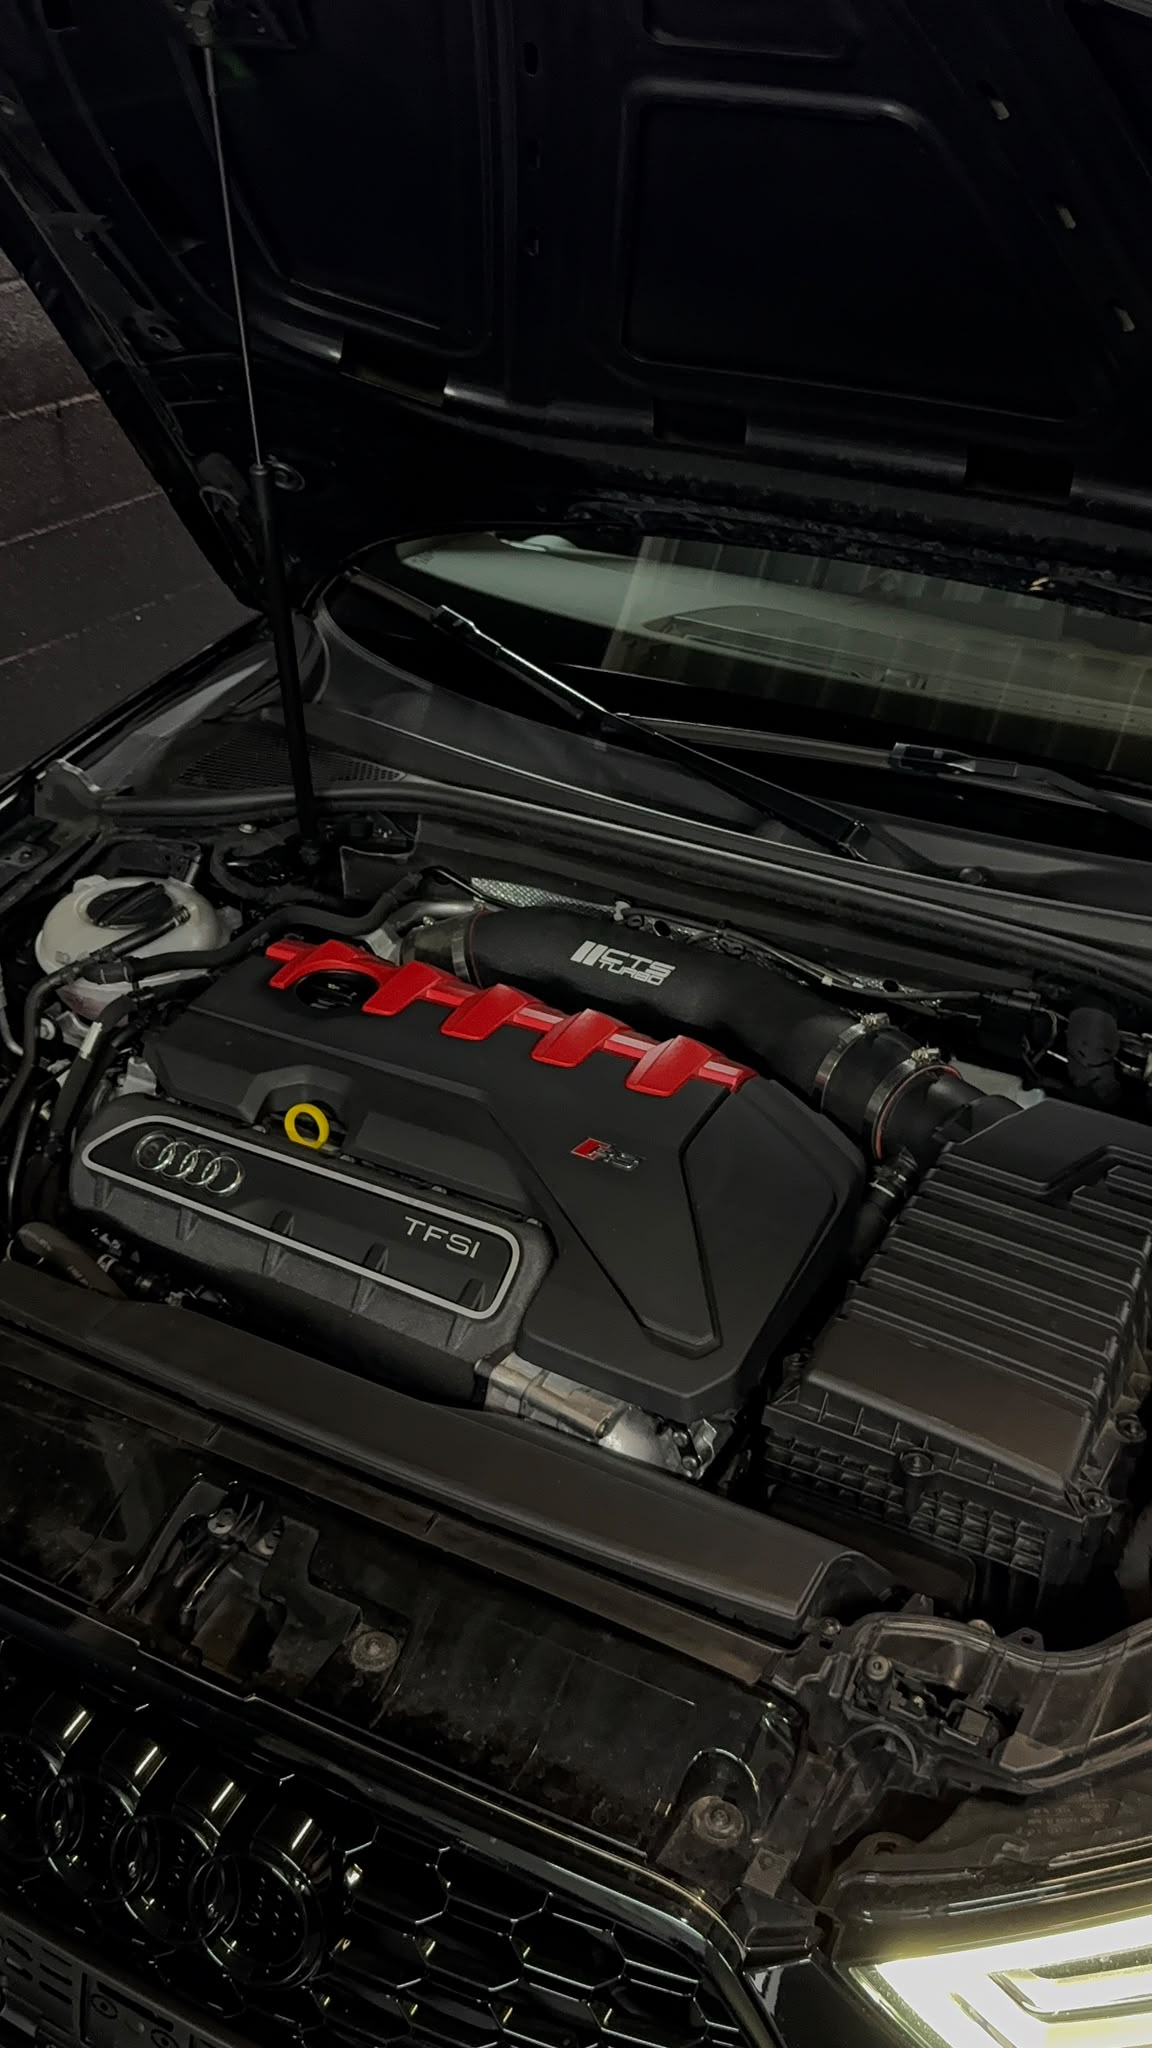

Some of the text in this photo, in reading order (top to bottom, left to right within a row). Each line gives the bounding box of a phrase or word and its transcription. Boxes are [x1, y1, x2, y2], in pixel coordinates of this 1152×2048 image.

[598, 960, 665, 986] TURBO
[600, 948, 677, 979] CTS
[404, 1215, 481, 1259] TFSI
